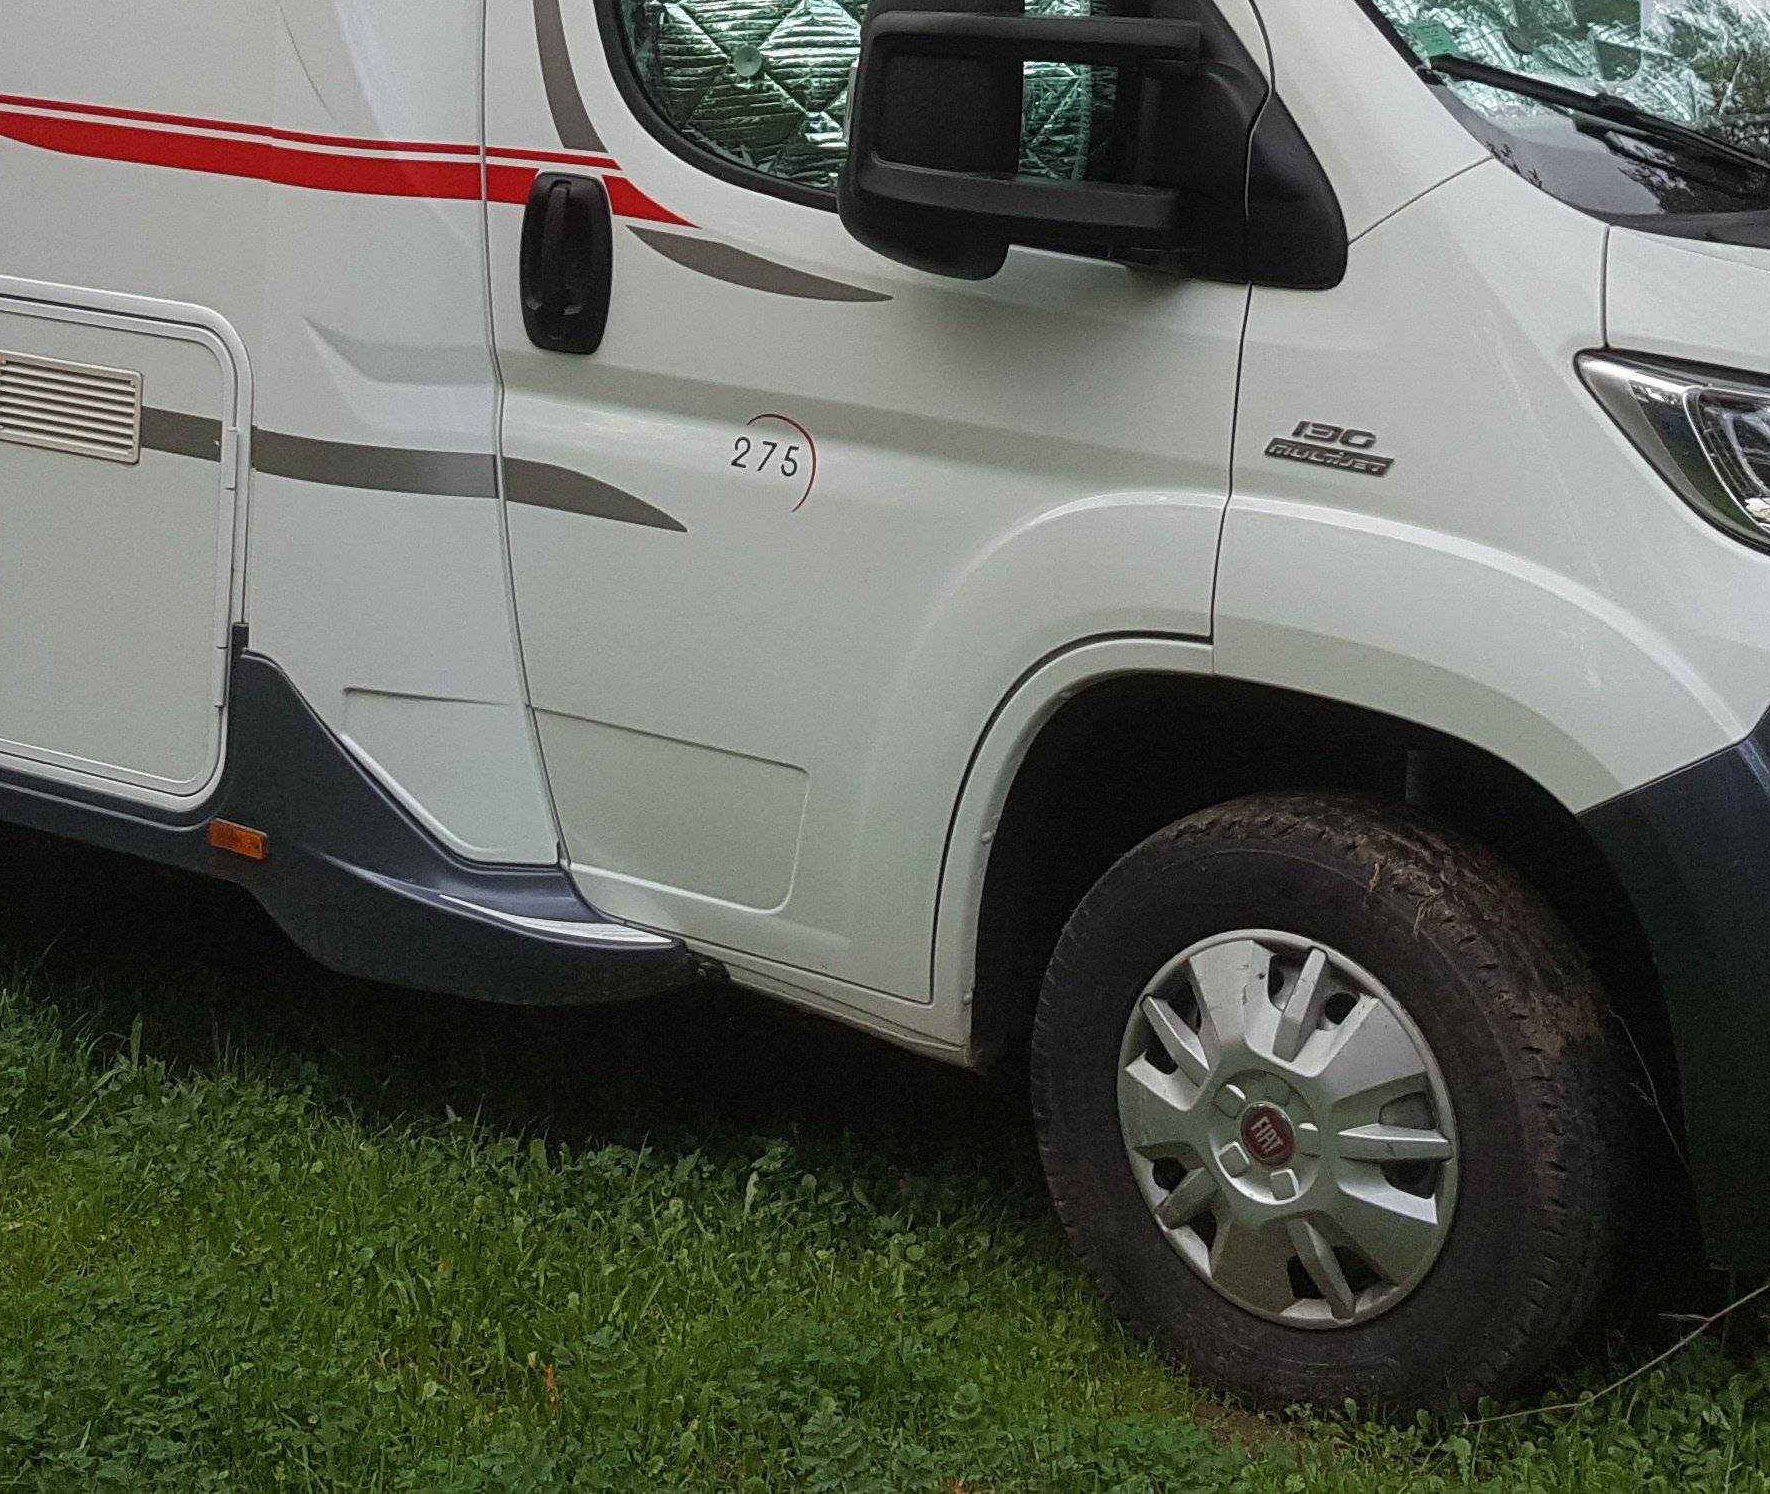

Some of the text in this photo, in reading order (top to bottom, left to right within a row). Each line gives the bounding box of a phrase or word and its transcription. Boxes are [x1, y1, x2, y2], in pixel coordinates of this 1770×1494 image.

[1291, 420, 1377, 450] 130
[730, 436, 800, 477] 275
[1249, 1115, 1285, 1154] FIAT
